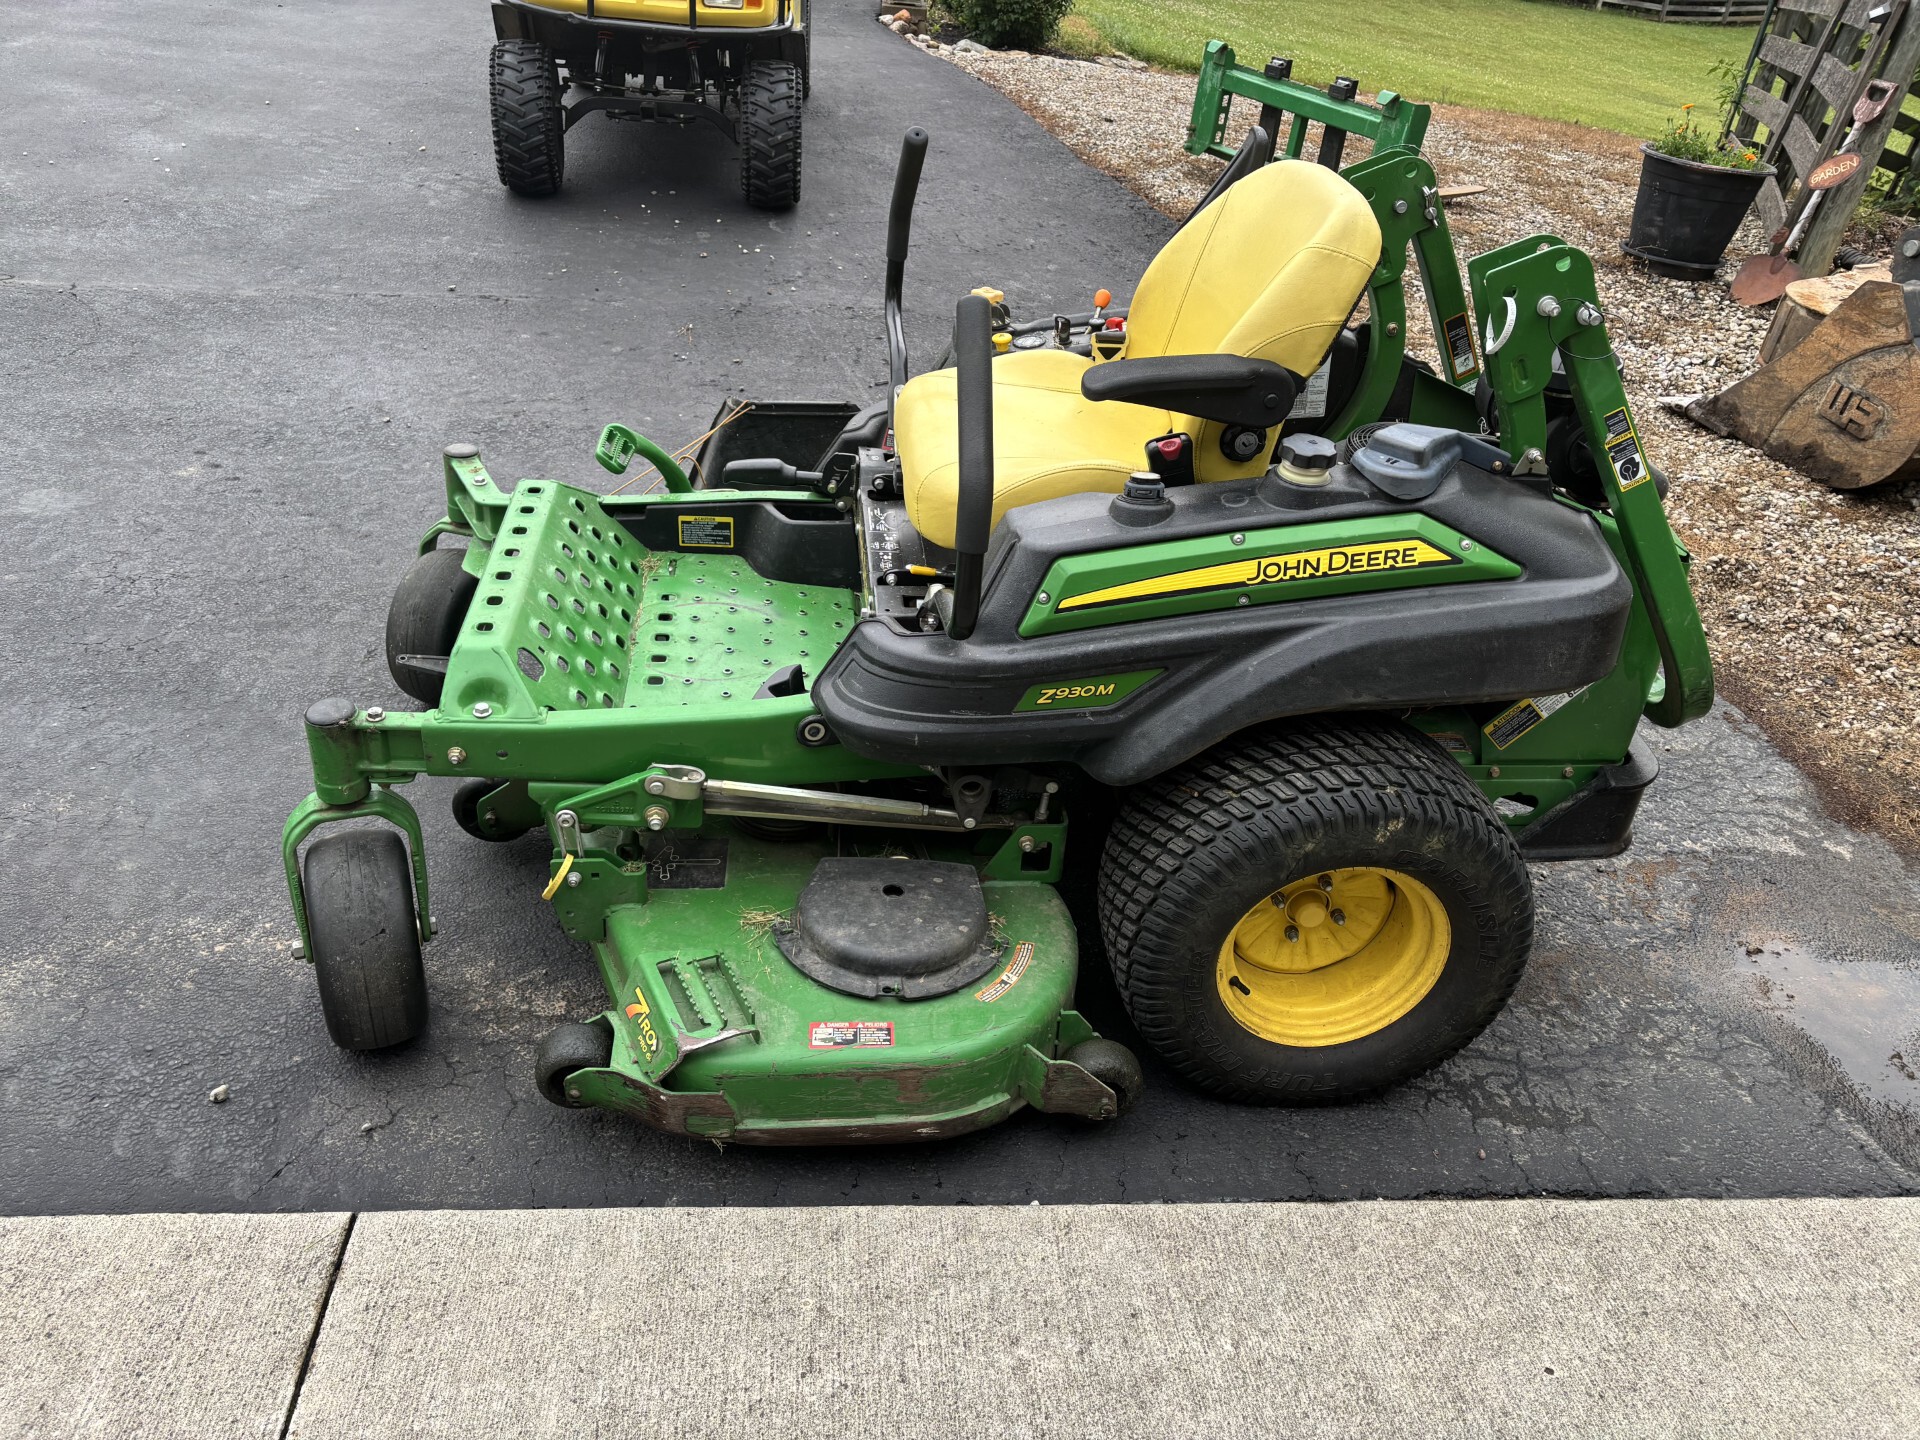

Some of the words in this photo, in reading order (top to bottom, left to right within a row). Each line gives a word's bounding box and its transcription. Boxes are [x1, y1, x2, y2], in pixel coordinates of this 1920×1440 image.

[1811, 157, 1857, 184] GARDEN
[1246, 556, 1321, 582] JOHN
[1328, 546, 1418, 572] DEERE
[1036, 683, 1116, 704] Z930M
[1392, 849, 1499, 972] CARLISLE
[1183, 951, 1244, 1071] MASTER
[637, 1034, 648, 1053] PRO
[1240, 1066, 1338, 1092] TURF
